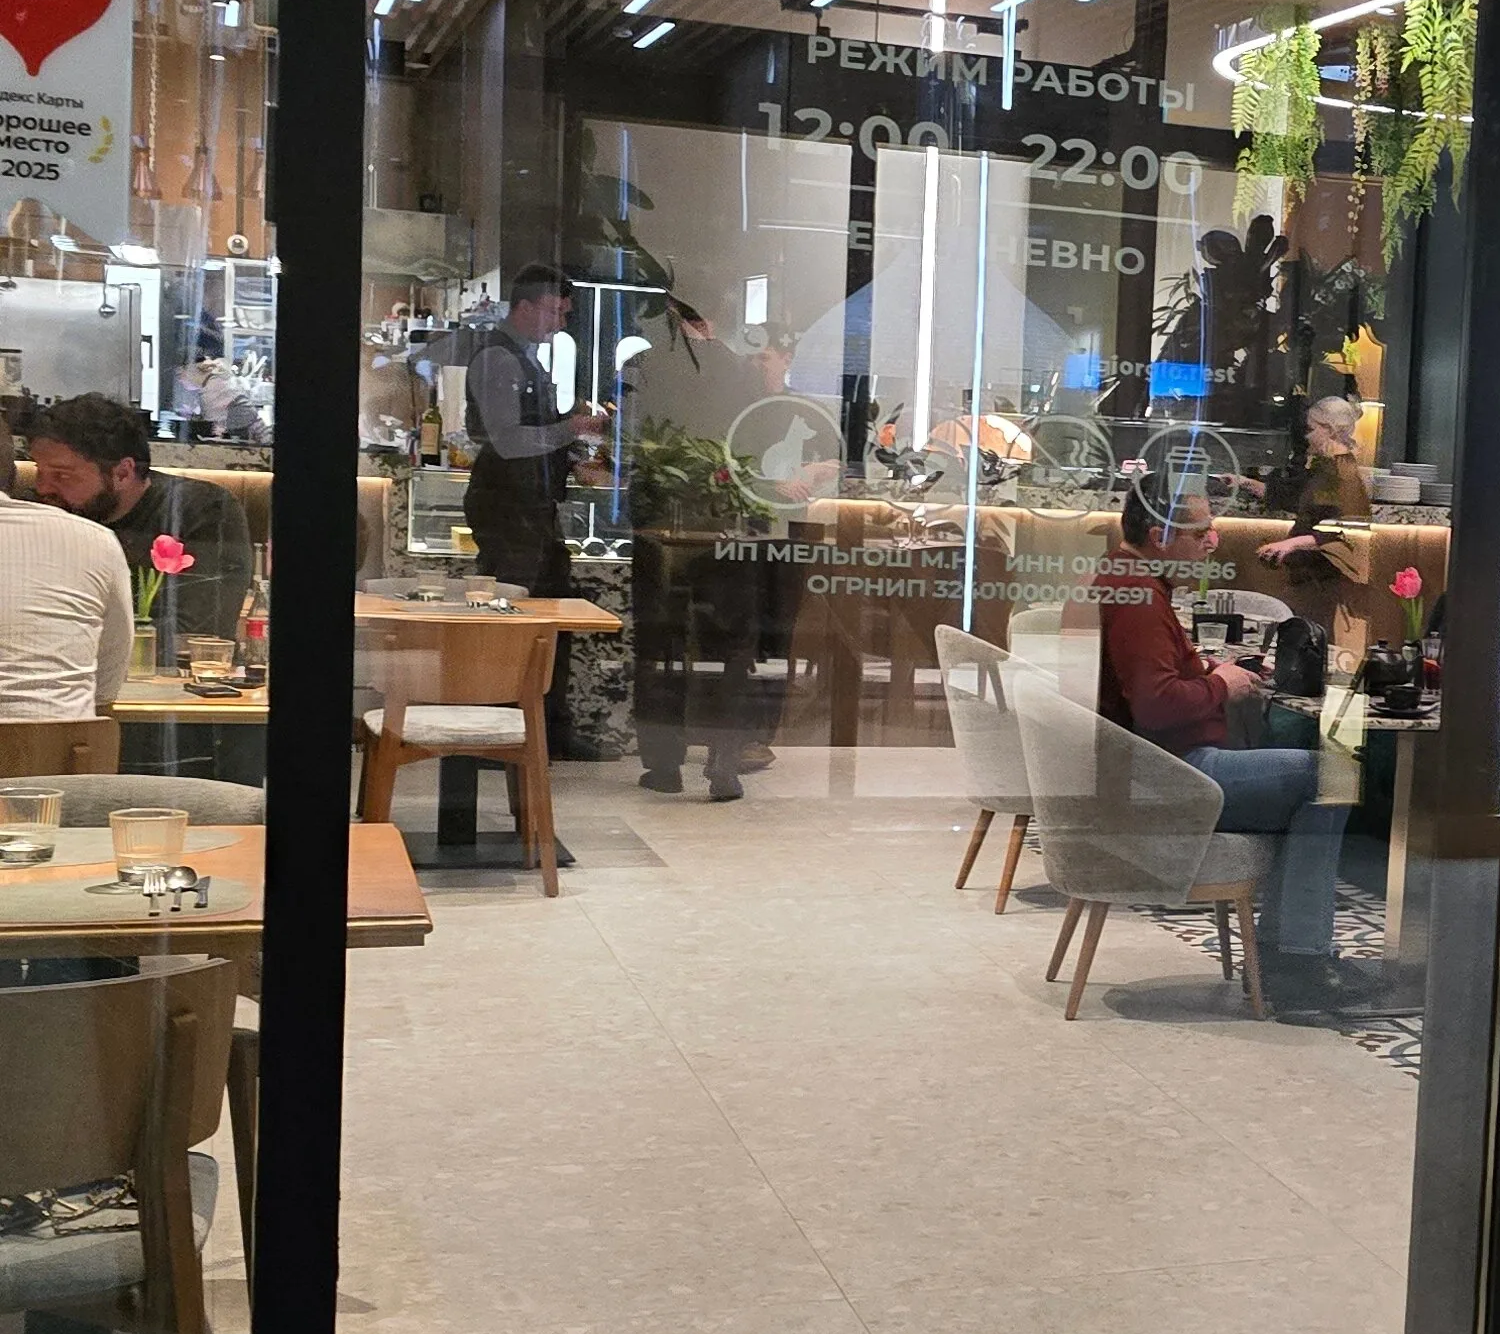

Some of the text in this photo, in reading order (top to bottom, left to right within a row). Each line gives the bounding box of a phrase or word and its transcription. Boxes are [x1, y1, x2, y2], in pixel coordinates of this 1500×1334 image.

[807, 35, 1195, 112] РЕЖИМ РАБОТЫ
[37, 92, 84, 109] Карты
[1, 159, 60, 181] 2025
[1020, 133, 1204, 196] 22:00
[848, 220, 1146, 276] ЕНЕВНО
[714, 541, 758, 562] ИП
[766, 543, 911, 567] МЕЛЬГОШ
[1005, 554, 1064, 574] ИНН
[1071, 555, 1236, 580] 010515975886
[806, 574, 1153, 605] ОГРНИП 32010000032691
